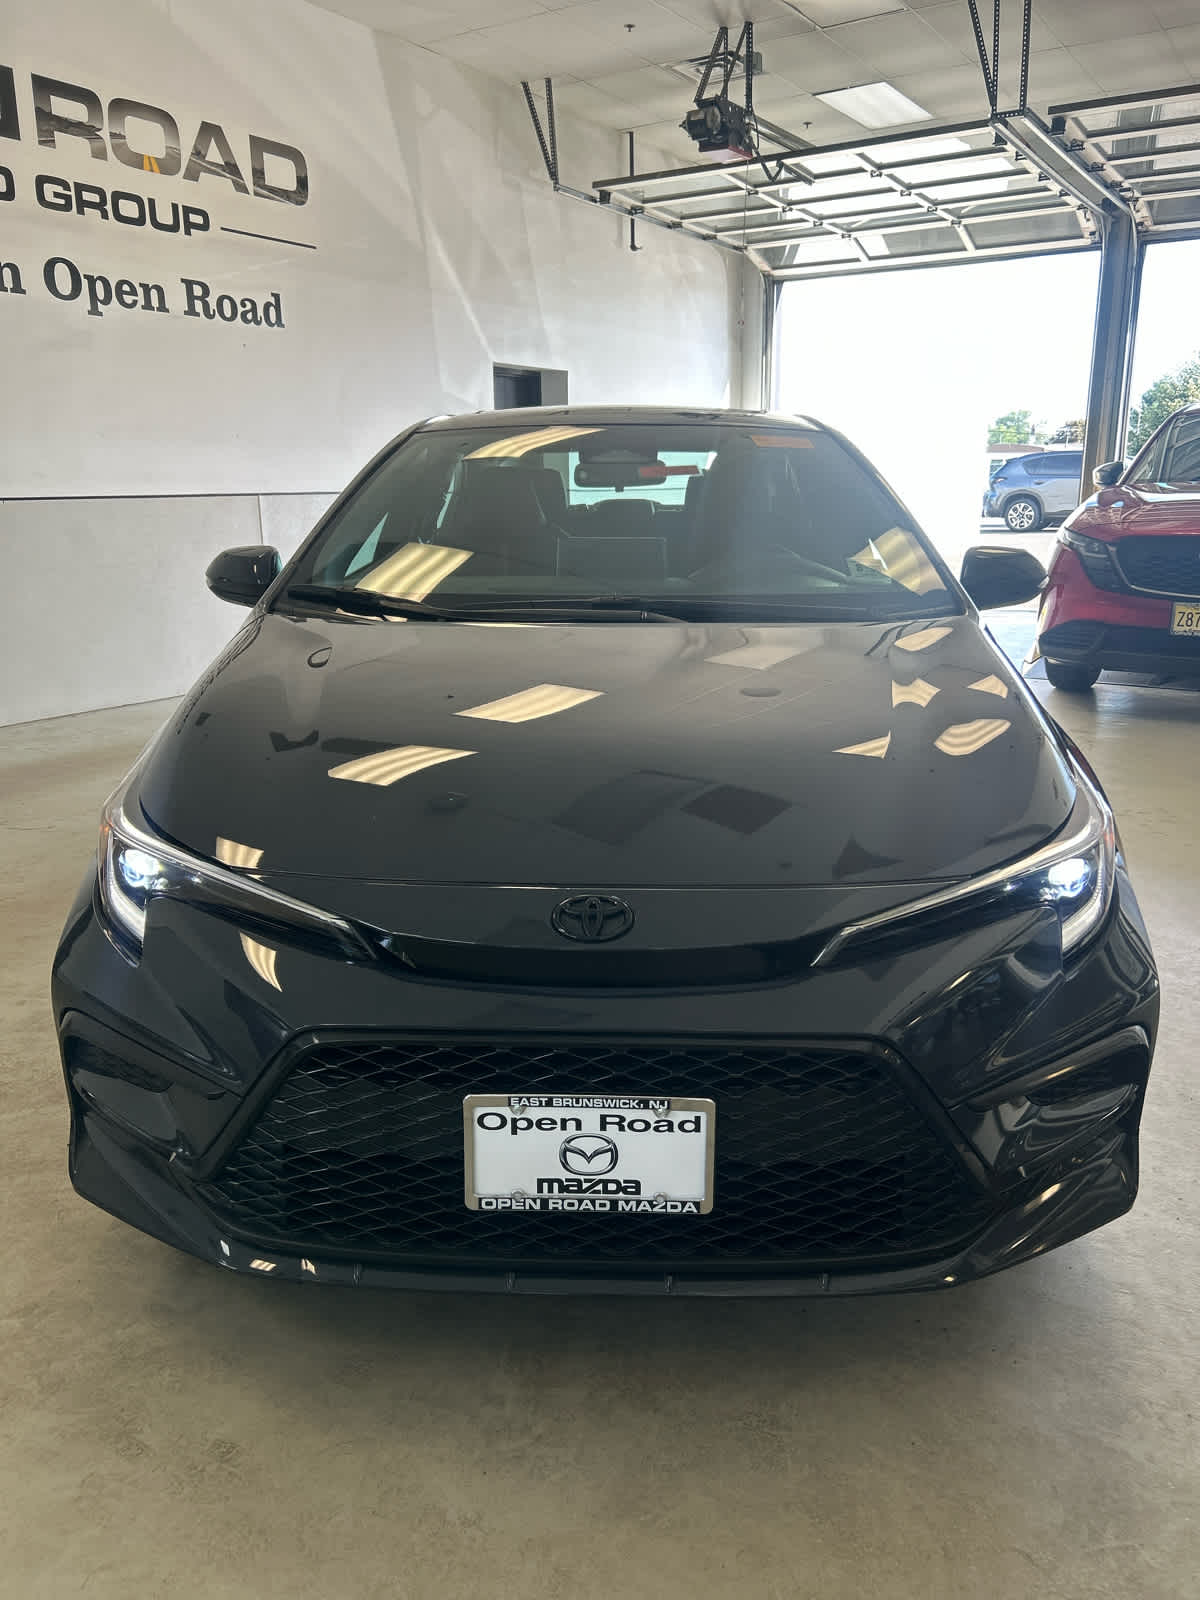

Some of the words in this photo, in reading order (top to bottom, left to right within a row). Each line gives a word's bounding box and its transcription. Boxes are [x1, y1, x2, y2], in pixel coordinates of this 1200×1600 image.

[35, 174, 210, 236] GROUP
[43, 256, 170, 317] Open
[180, 277, 286, 329] Road
[510, 1097, 548, 1108] EAST
[552, 1098, 644, 1110] BRUNSWICK,
[649, 1100, 669, 1110] NJ
[476, 1111, 583, 1136] Open
[599, 1114, 701, 1134] Road
[480, 1198, 541, 1211] OPEN
[549, 1199, 611, 1212] ROAD
[617, 1200, 699, 1214] MAZDA
